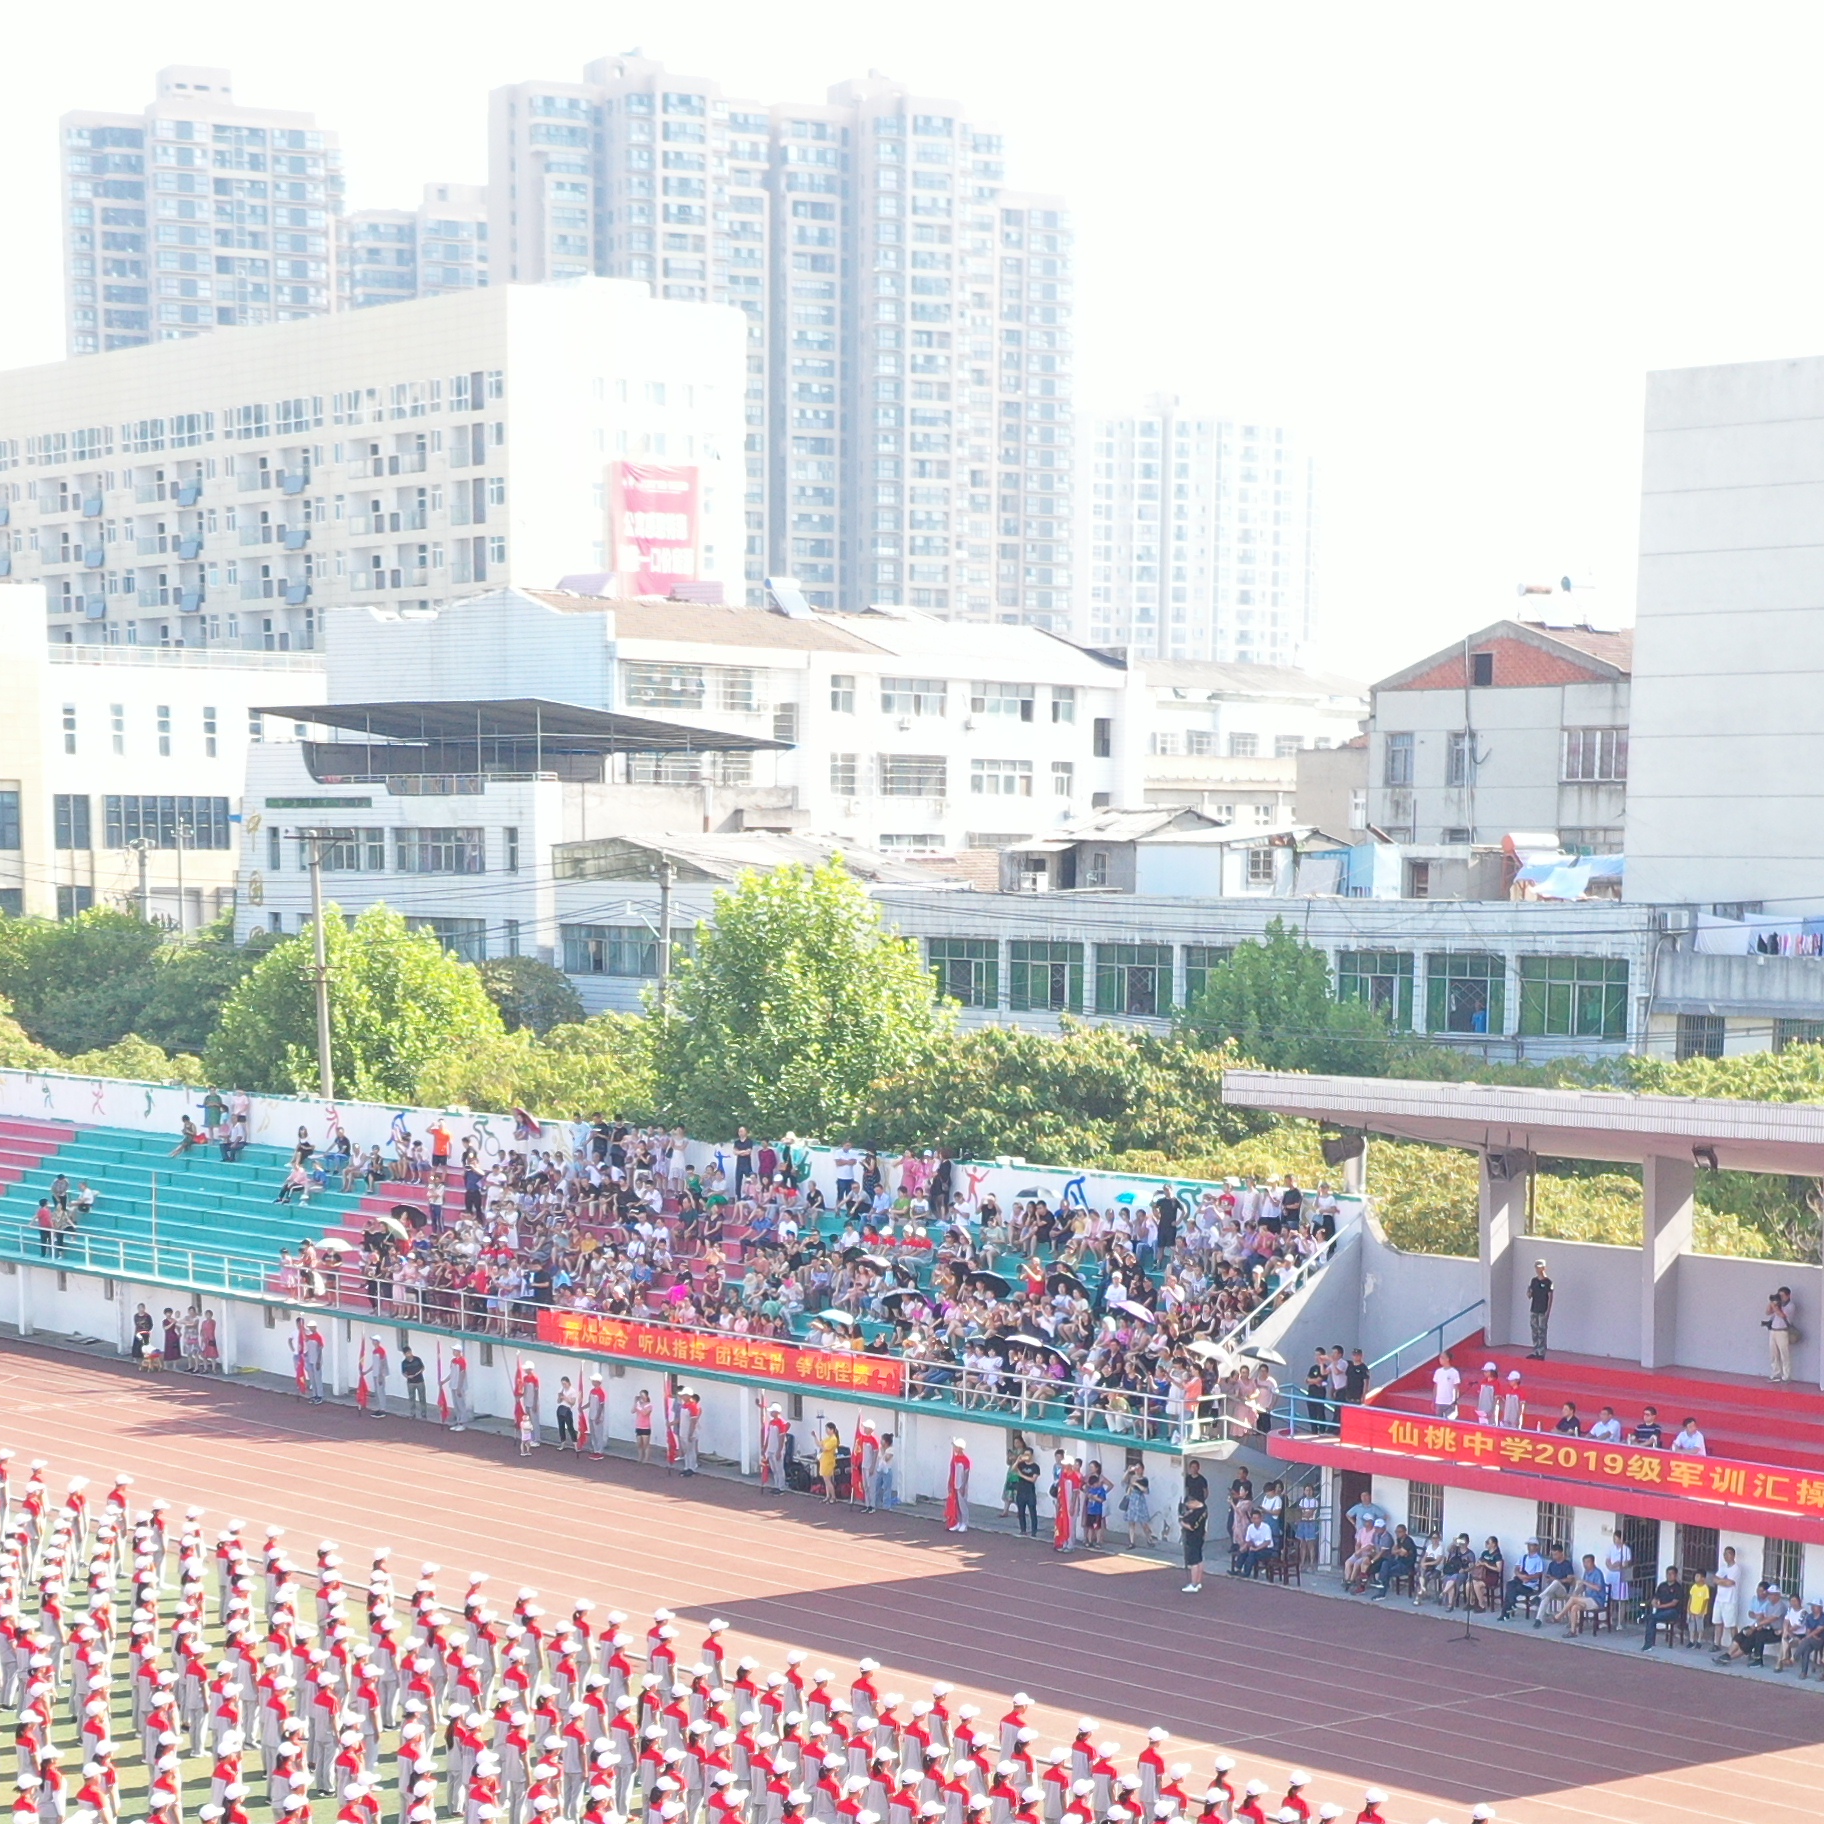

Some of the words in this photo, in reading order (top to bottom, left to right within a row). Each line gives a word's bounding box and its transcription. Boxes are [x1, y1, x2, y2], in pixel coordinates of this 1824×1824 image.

[638, 1335, 706, 1362] 听从指挥
[715, 1346, 786, 1374] 团结互助
